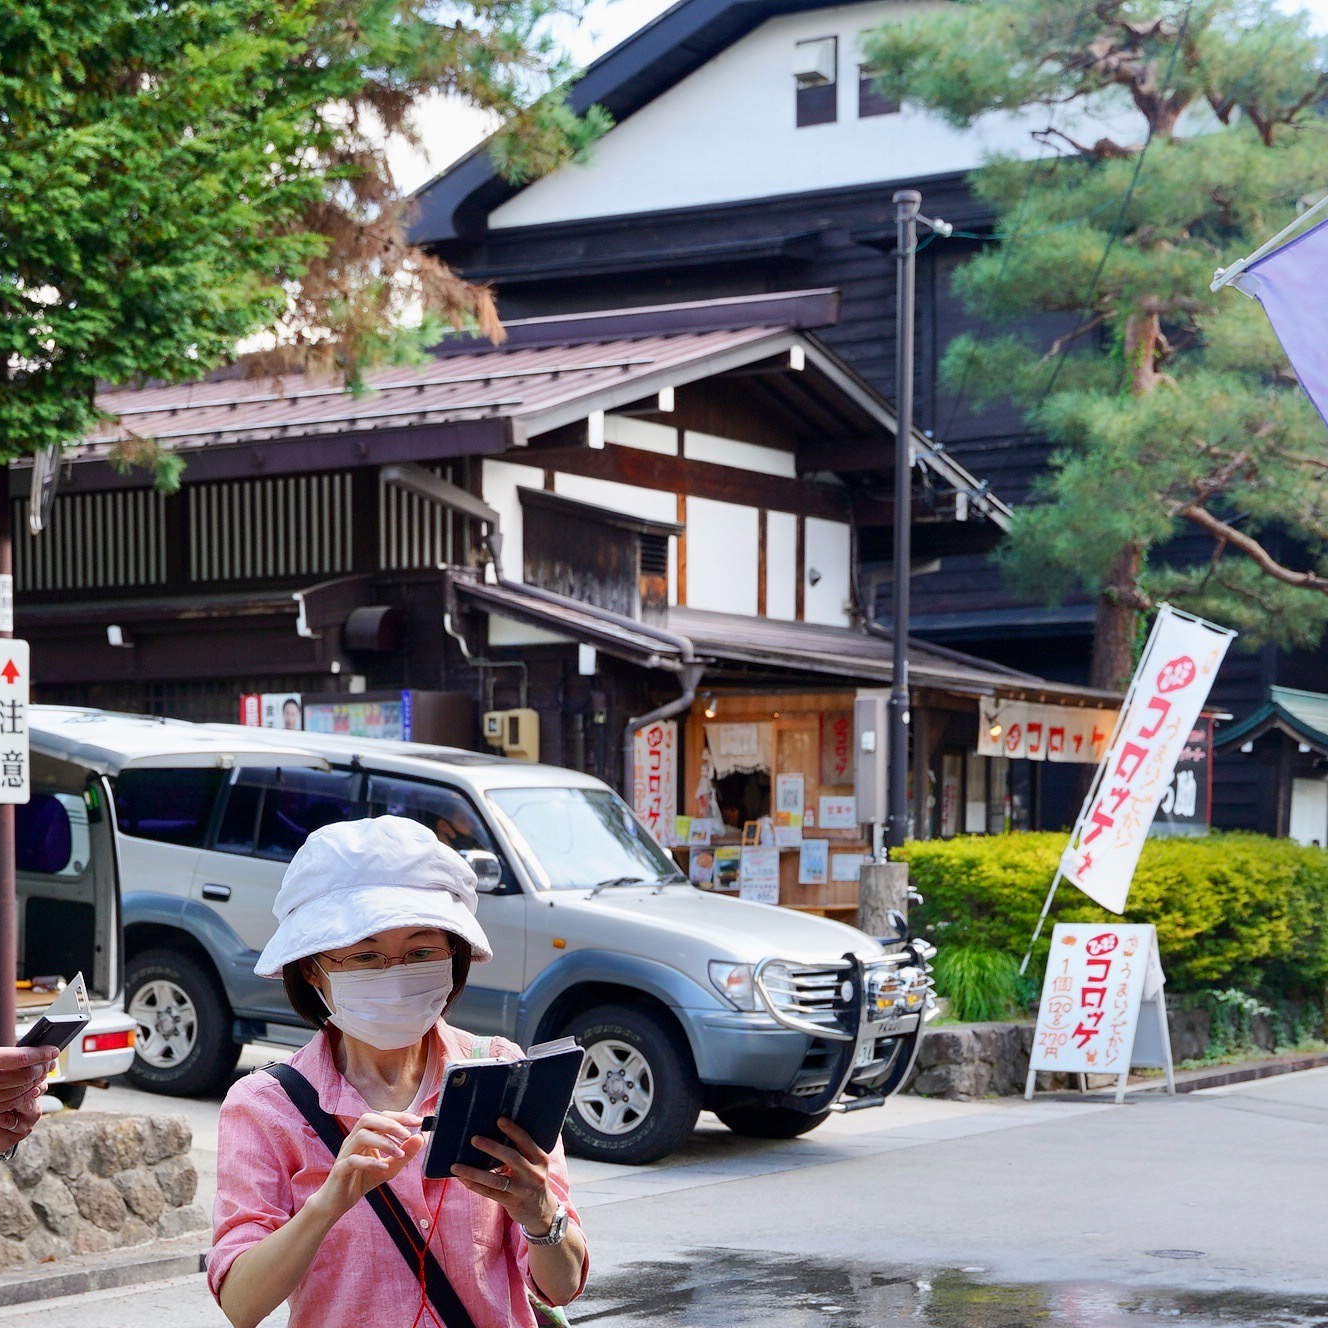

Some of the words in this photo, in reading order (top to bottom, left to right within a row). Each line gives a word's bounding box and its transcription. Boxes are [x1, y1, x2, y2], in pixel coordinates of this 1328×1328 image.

[648, 750, 661, 829] コロッケ
[1083, 696, 1172, 845] コロッケ
[1072, 958, 1112, 1049] コロッケ
